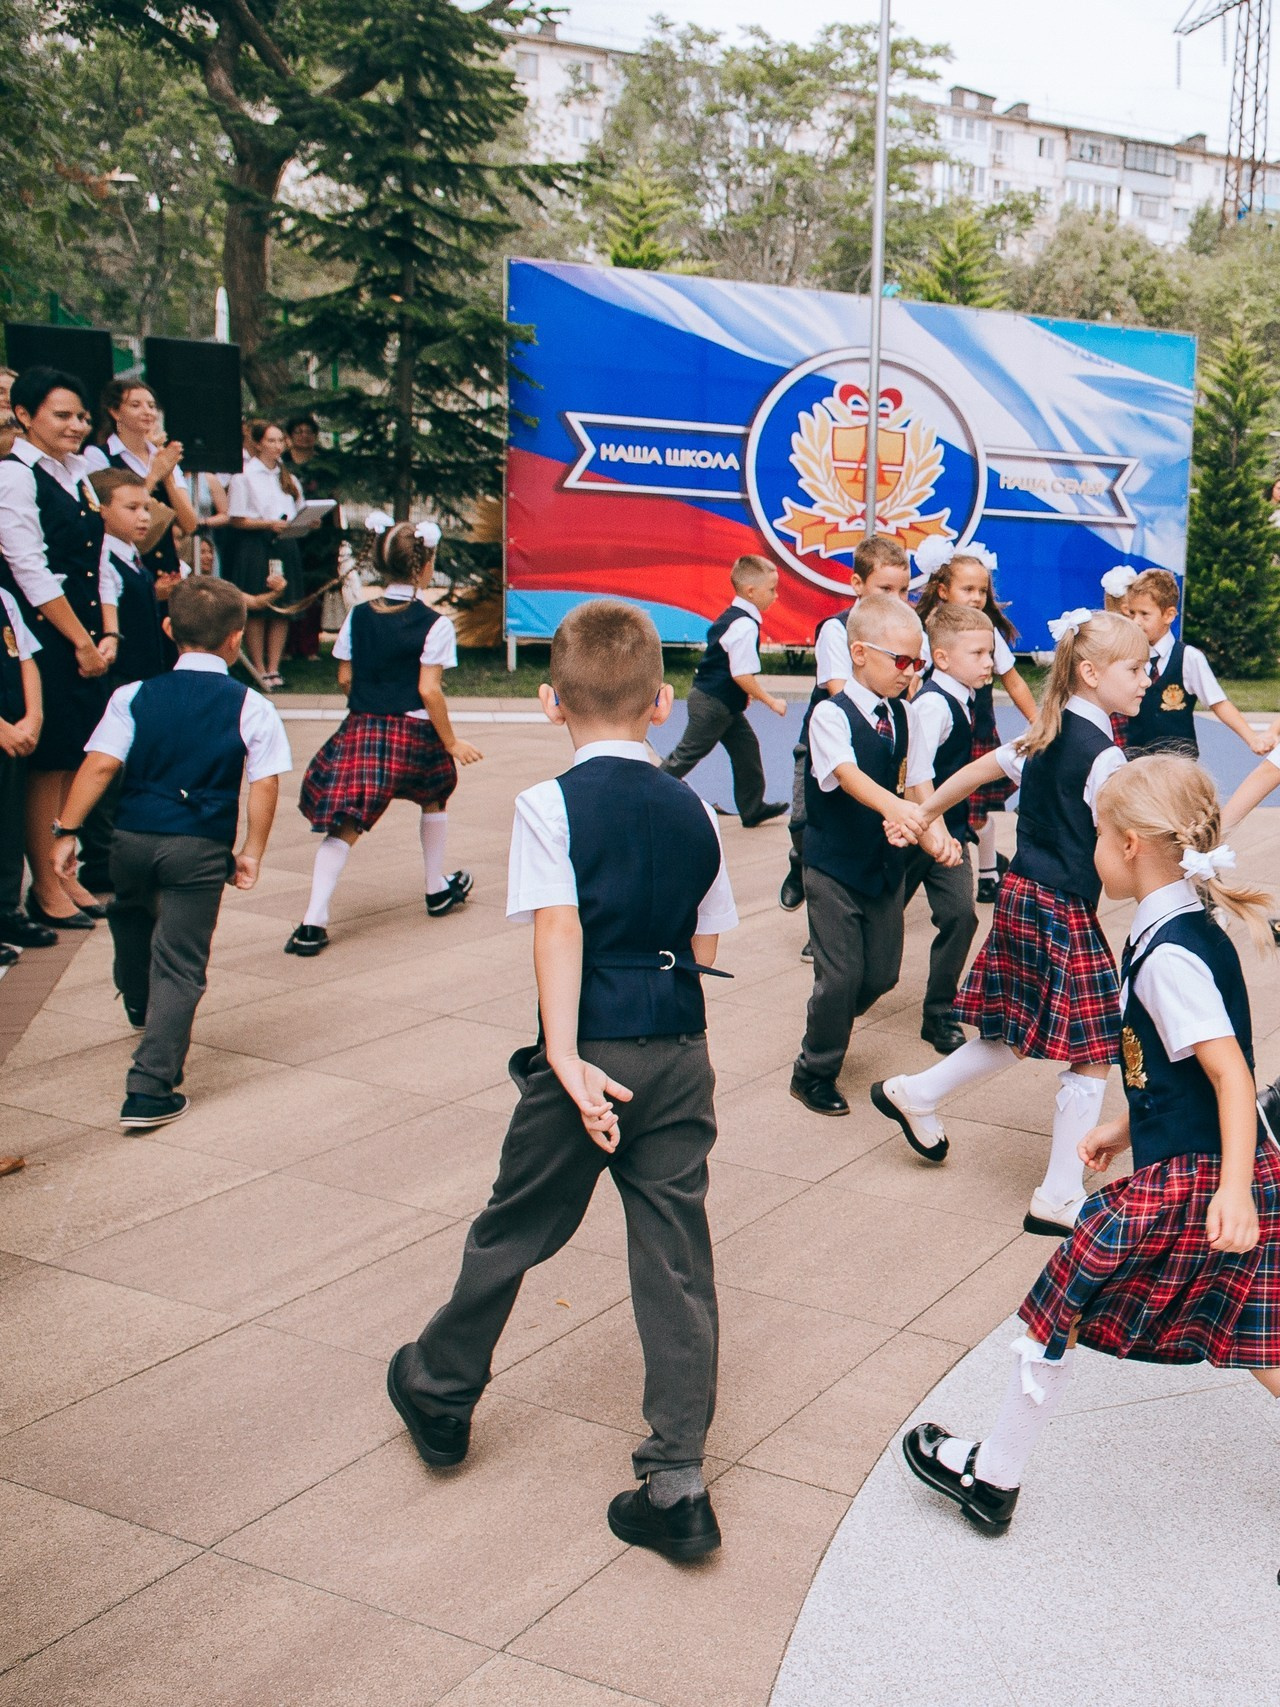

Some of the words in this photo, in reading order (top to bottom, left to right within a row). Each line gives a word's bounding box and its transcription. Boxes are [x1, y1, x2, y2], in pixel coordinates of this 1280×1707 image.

[600, 443, 663, 465] НАША
[665, 447, 740, 471] ШКОЛА
[999, 473, 1047, 492] НАША
